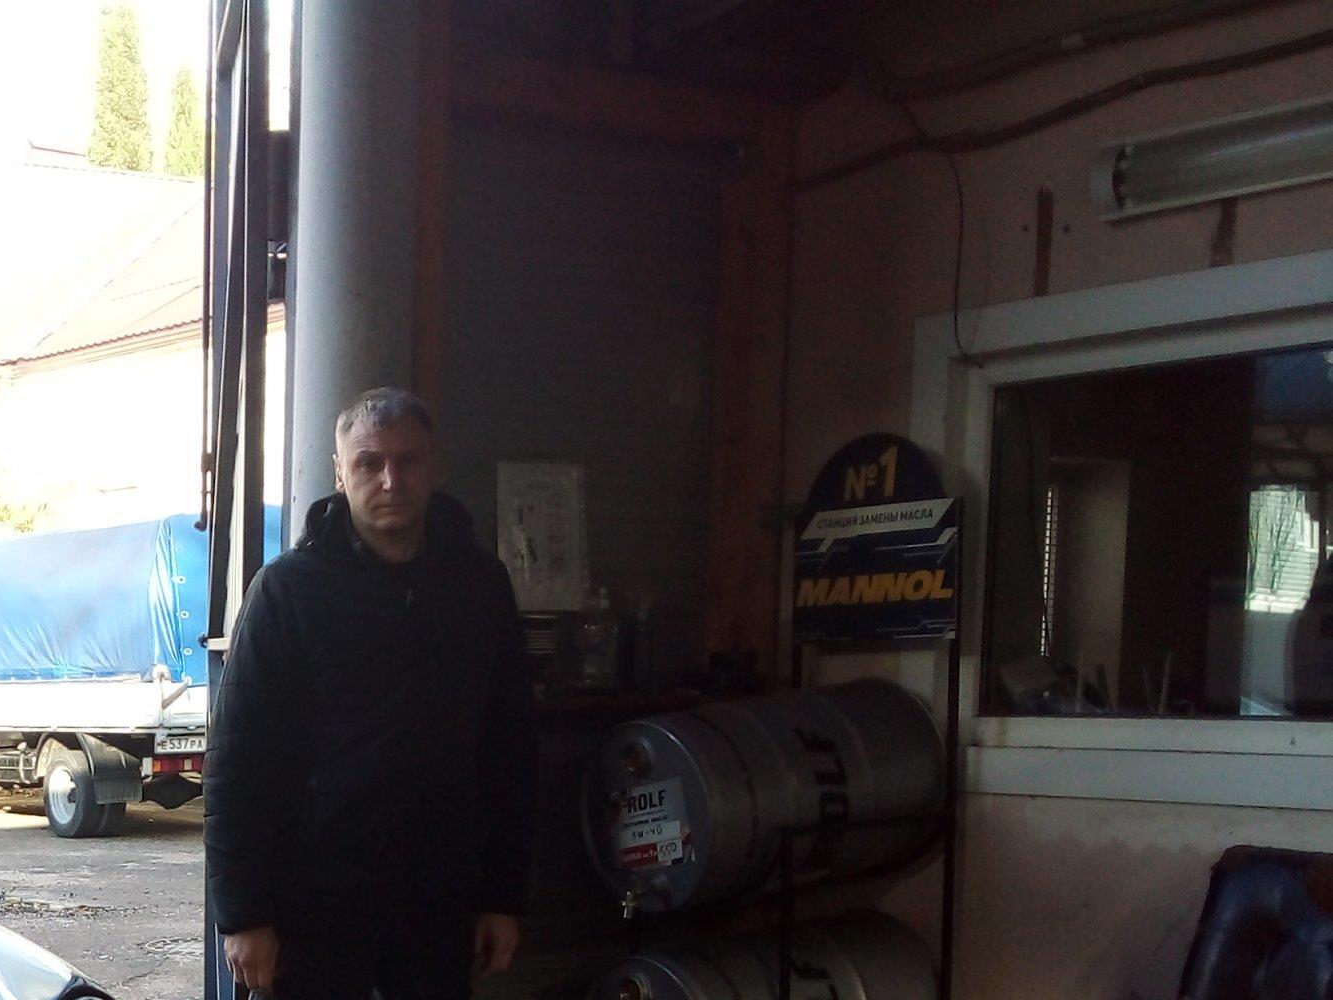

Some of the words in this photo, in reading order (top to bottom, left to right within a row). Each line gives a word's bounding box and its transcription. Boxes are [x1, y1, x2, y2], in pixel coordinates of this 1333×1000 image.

[859, 512, 900, 526] ЗАМЕНЫ
[900, 508, 933, 522] МАСЛА
[796, 568, 956, 607] MANNOL
[628, 789, 666, 813] ROLF
